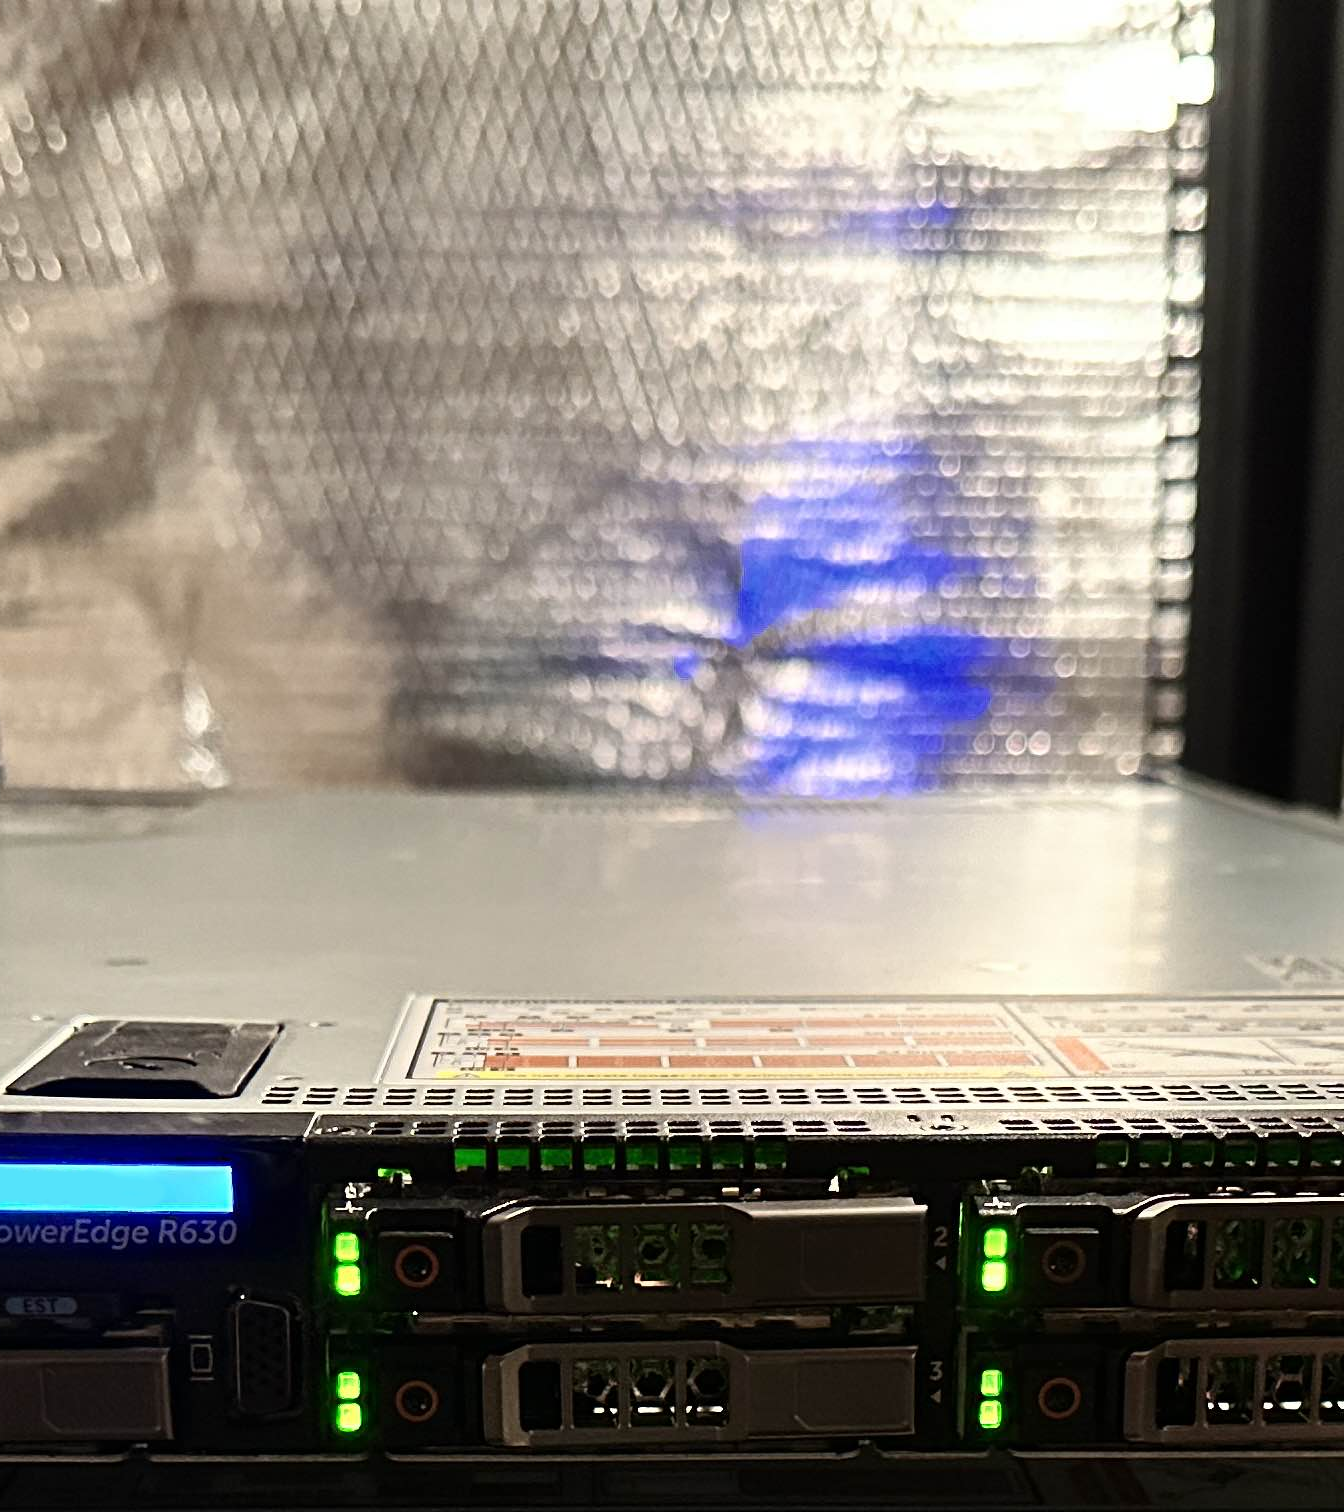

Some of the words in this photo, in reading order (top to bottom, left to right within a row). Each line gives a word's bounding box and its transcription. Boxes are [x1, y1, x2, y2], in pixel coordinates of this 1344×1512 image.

[157, 1219, 238, 1246] R630
[933, 1226, 948, 1247] 2
[22, 1297, 59, 1313] EST
[930, 1360, 943, 1382] 3
